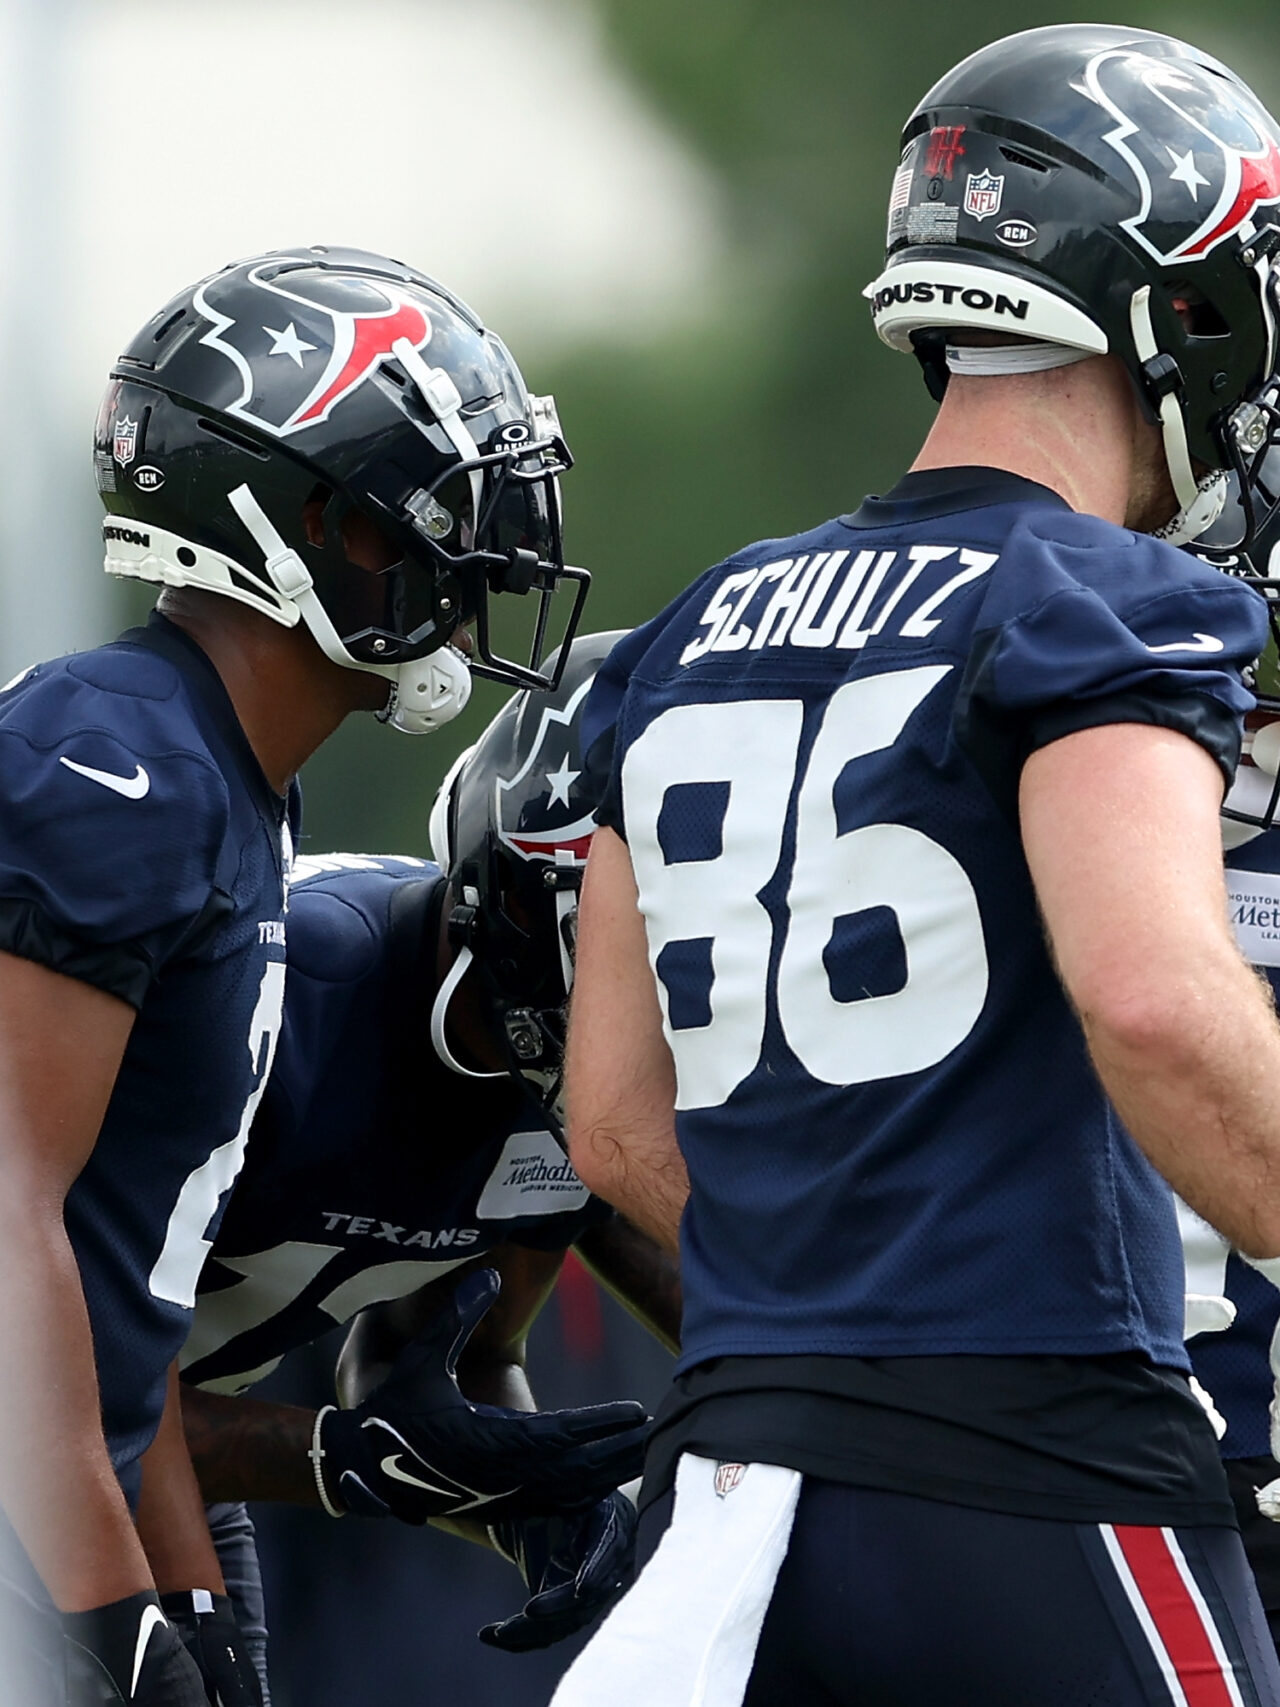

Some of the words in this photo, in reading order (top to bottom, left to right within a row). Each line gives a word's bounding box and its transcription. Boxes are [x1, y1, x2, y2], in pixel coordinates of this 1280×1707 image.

[969, 192, 996, 212] NFL
[871, 282, 1030, 320] HOUSTON
[104, 526, 150, 547] STON
[679, 545, 999, 666] SCHULTZ
[621, 664, 990, 1112] 86
[321, 1211, 480, 1249] TEXANS
